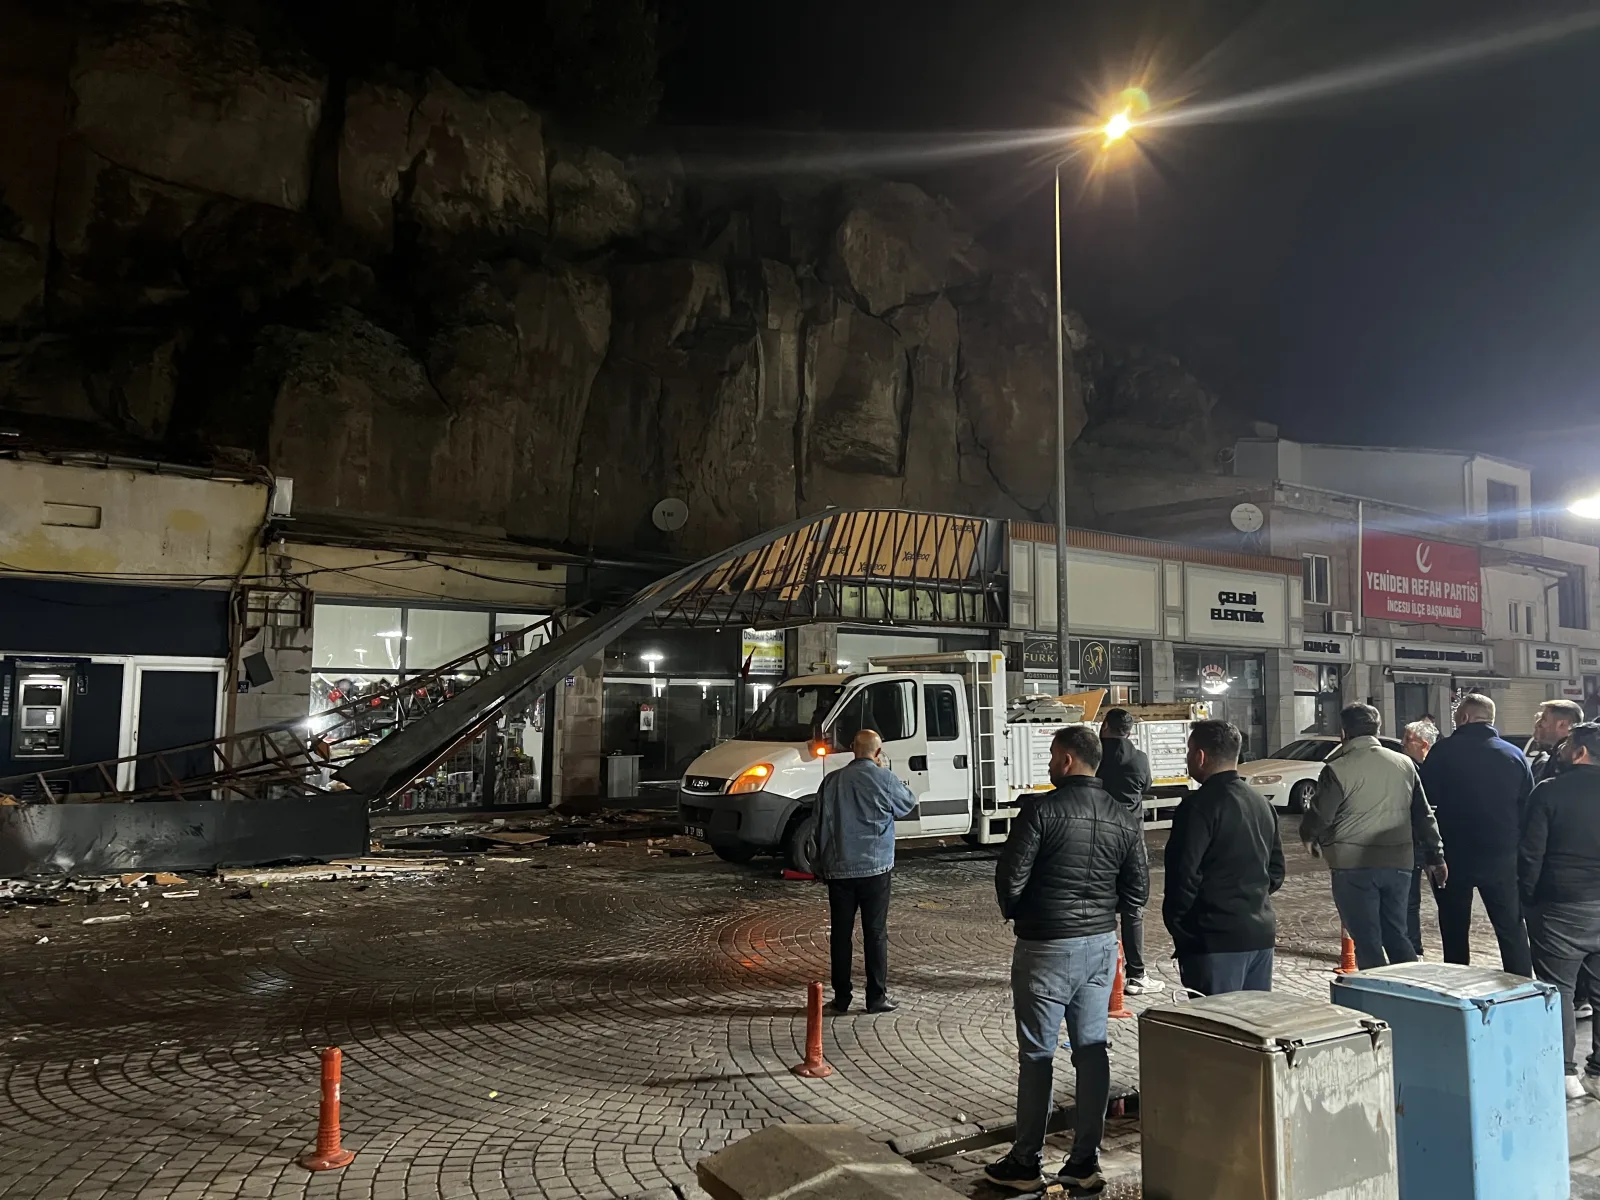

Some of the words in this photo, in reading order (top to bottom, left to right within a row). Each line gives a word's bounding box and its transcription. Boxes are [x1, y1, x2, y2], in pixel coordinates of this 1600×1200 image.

[1366, 570, 1409, 594] YENİDEN
[1411, 578, 1442, 598] REFAH
[1444, 581, 1478, 603] PARTİSİ
[1218, 591, 1257, 605] ÇELEBİ
[1211, 608, 1264, 623] ELEKTRİK
[1387, 597, 1410, 613] İNCESU
[1411, 600, 1425, 617] İLÇE
[1427, 604, 1462, 619] BAŞKANLIĞI
